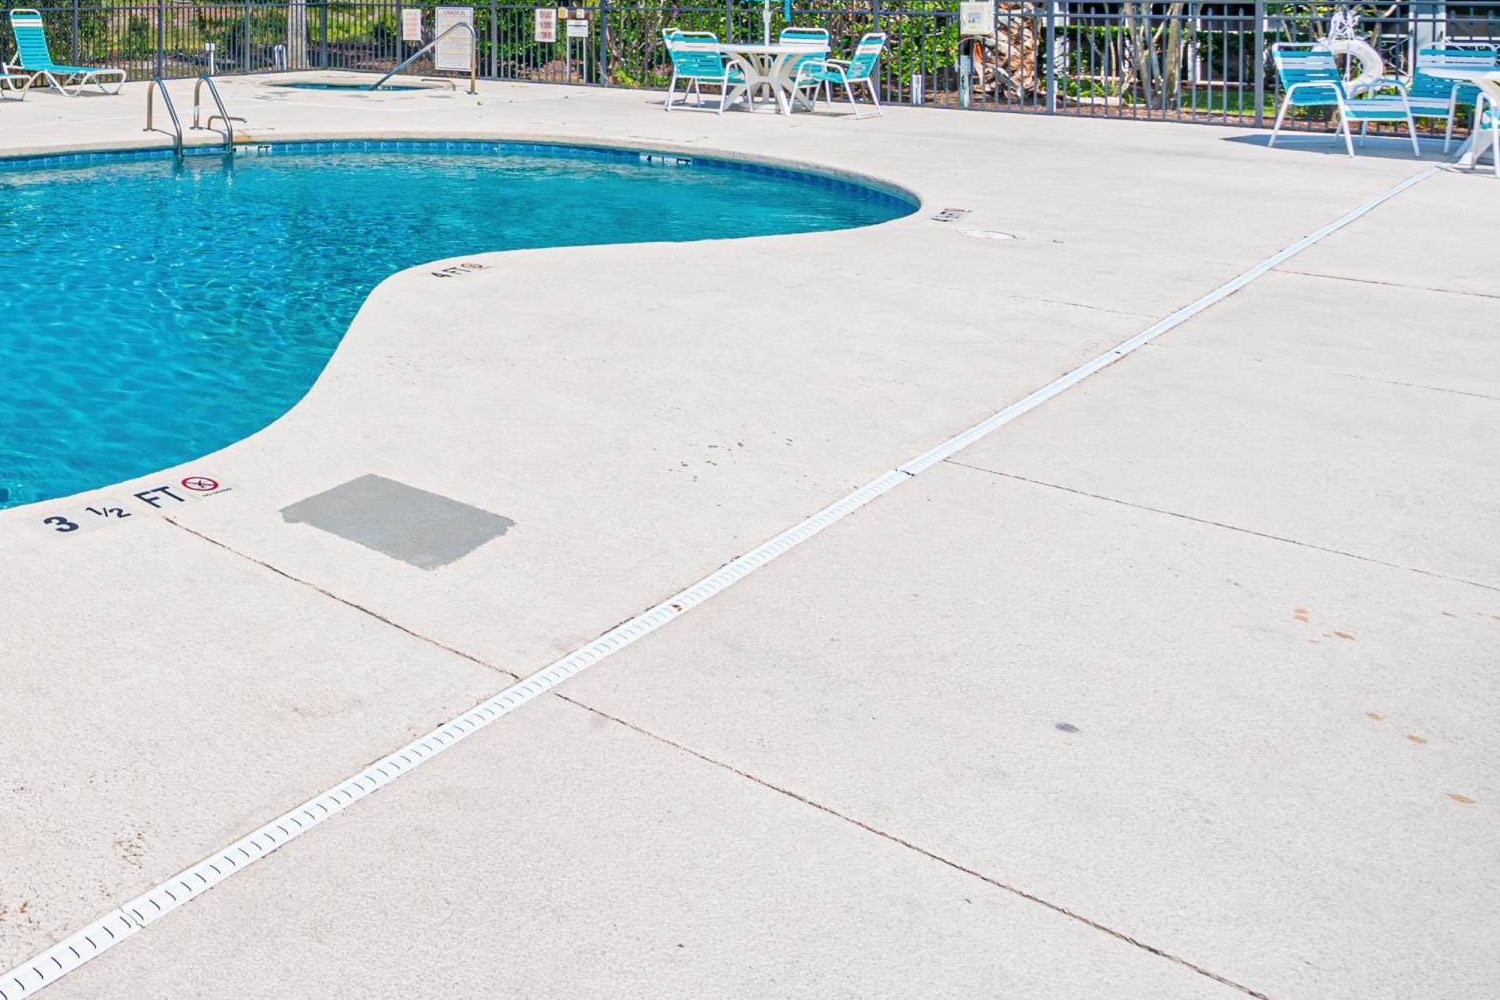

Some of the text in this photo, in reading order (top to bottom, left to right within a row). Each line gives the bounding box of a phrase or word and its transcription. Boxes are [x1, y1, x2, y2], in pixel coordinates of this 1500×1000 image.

[43, 516, 80, 533] 3
[85, 506, 132, 519] 1/2
[133, 485, 186, 509] FT
